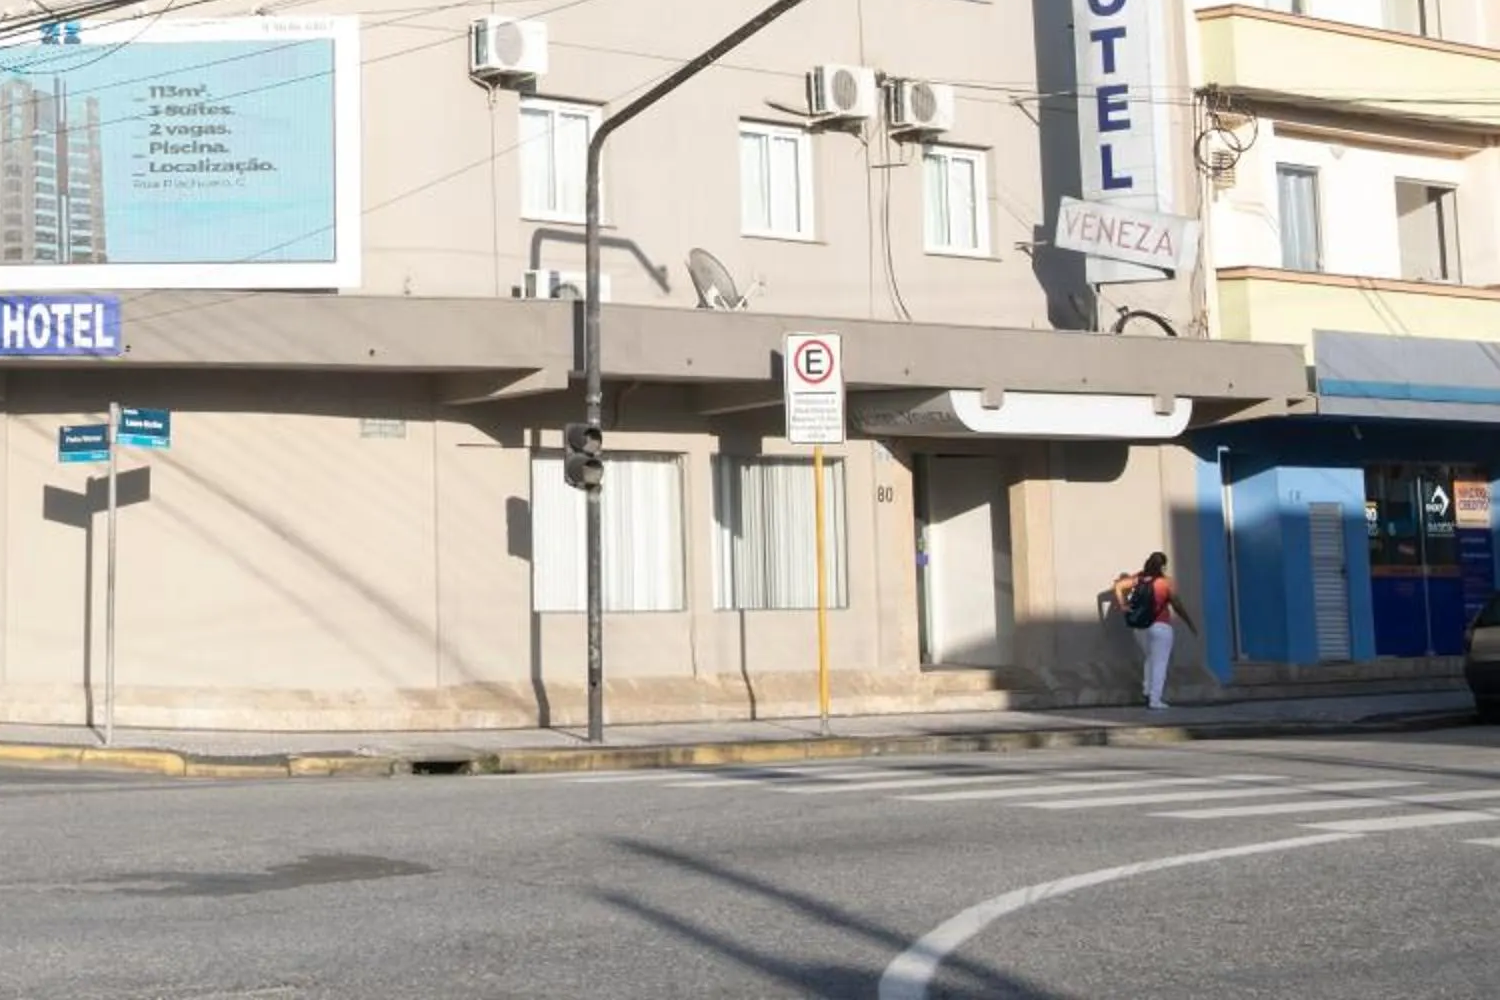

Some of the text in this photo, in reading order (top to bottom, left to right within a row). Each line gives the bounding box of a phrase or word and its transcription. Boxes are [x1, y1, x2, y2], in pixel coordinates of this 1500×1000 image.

[149, 123, 232, 138] 2 vagas.
[149, 141, 230, 154] Piscina.
[149, 157, 277, 175] Localização.
[1063, 208, 1174, 257] VENEZA
[3, 303, 115, 349] HOTEL
[805, 349, 823, 375] E
[877, 486, 893, 502] 80
